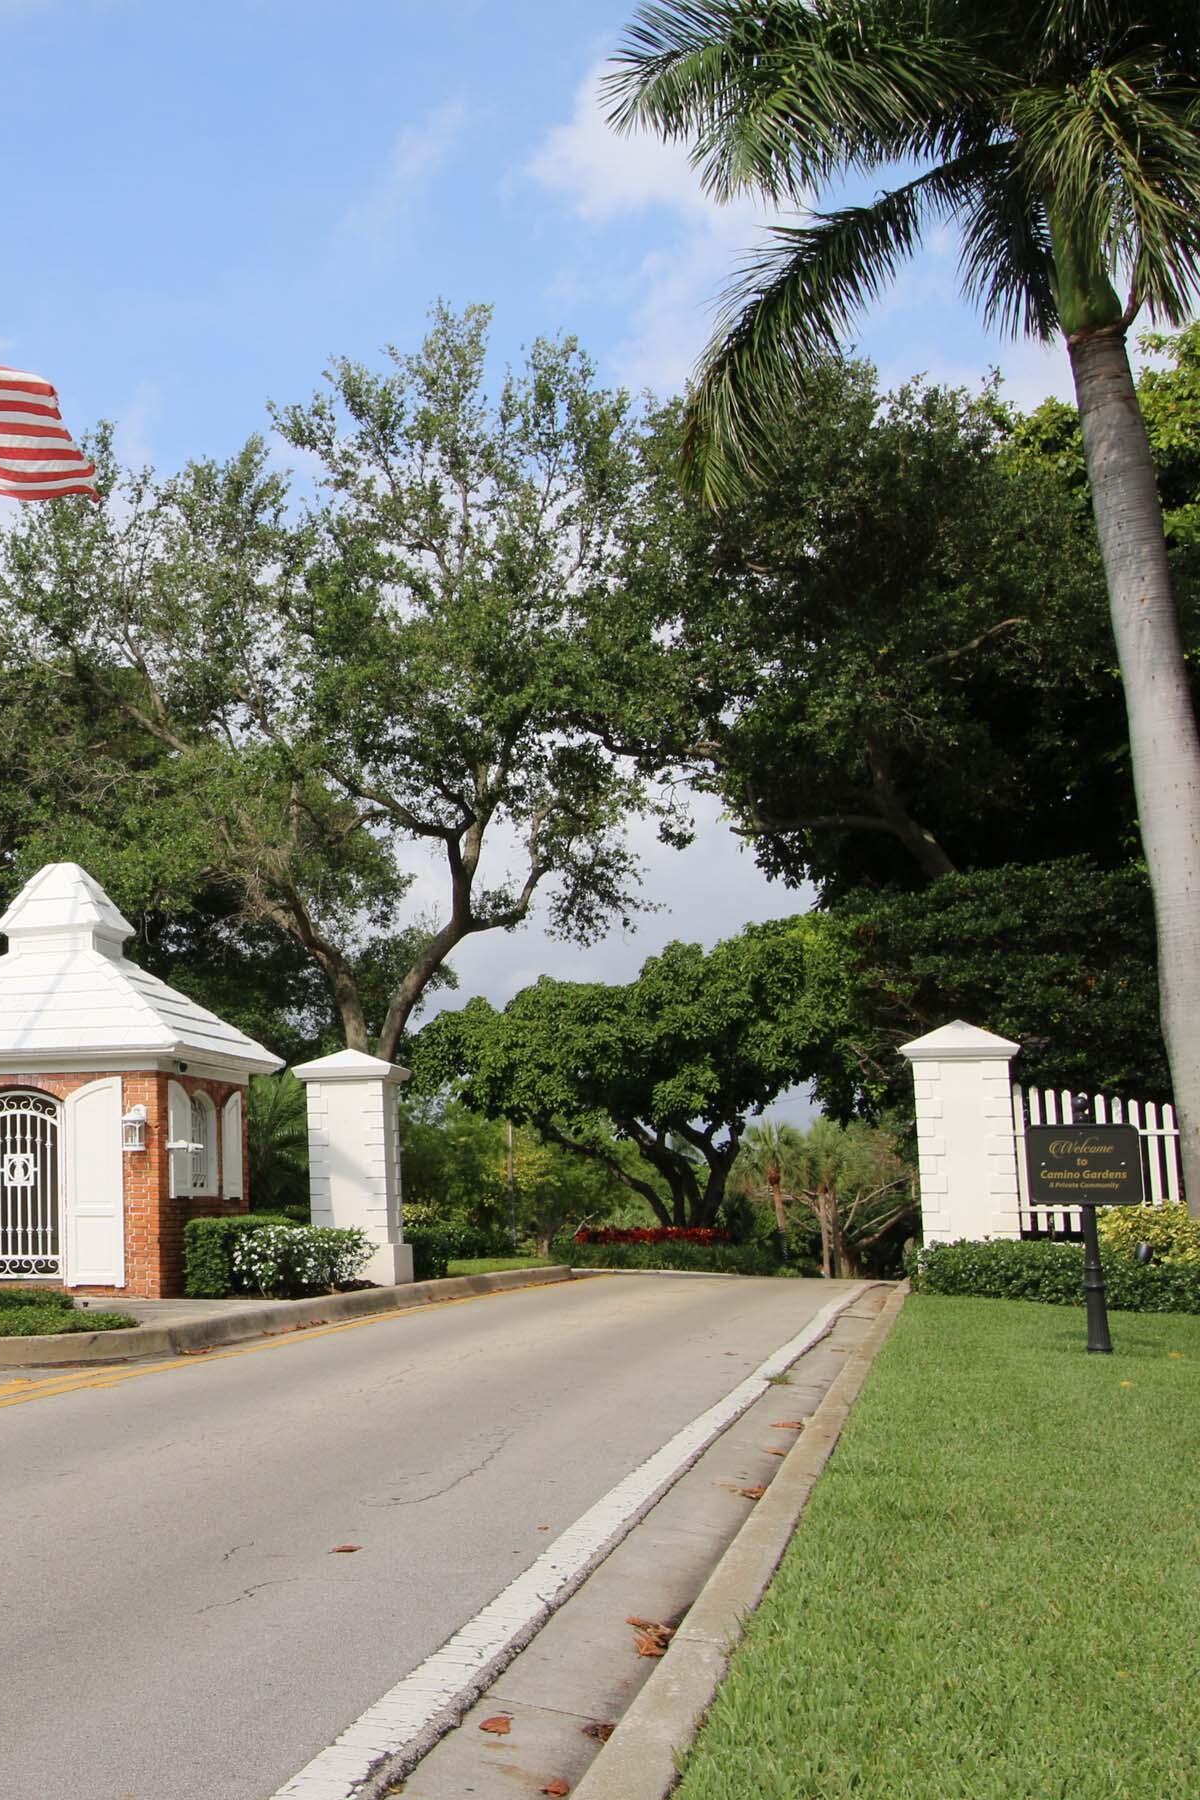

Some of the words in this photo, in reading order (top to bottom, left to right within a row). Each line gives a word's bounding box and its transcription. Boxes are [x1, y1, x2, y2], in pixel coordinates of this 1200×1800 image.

[1049, 1137, 1114, 1158] Welcome
[1076, 1158, 1088, 1166] to
[1040, 1170, 1080, 1179] Camino
[1082, 1170, 1128, 1179] Gardens
[1080, 1182, 1120, 1190] Community
